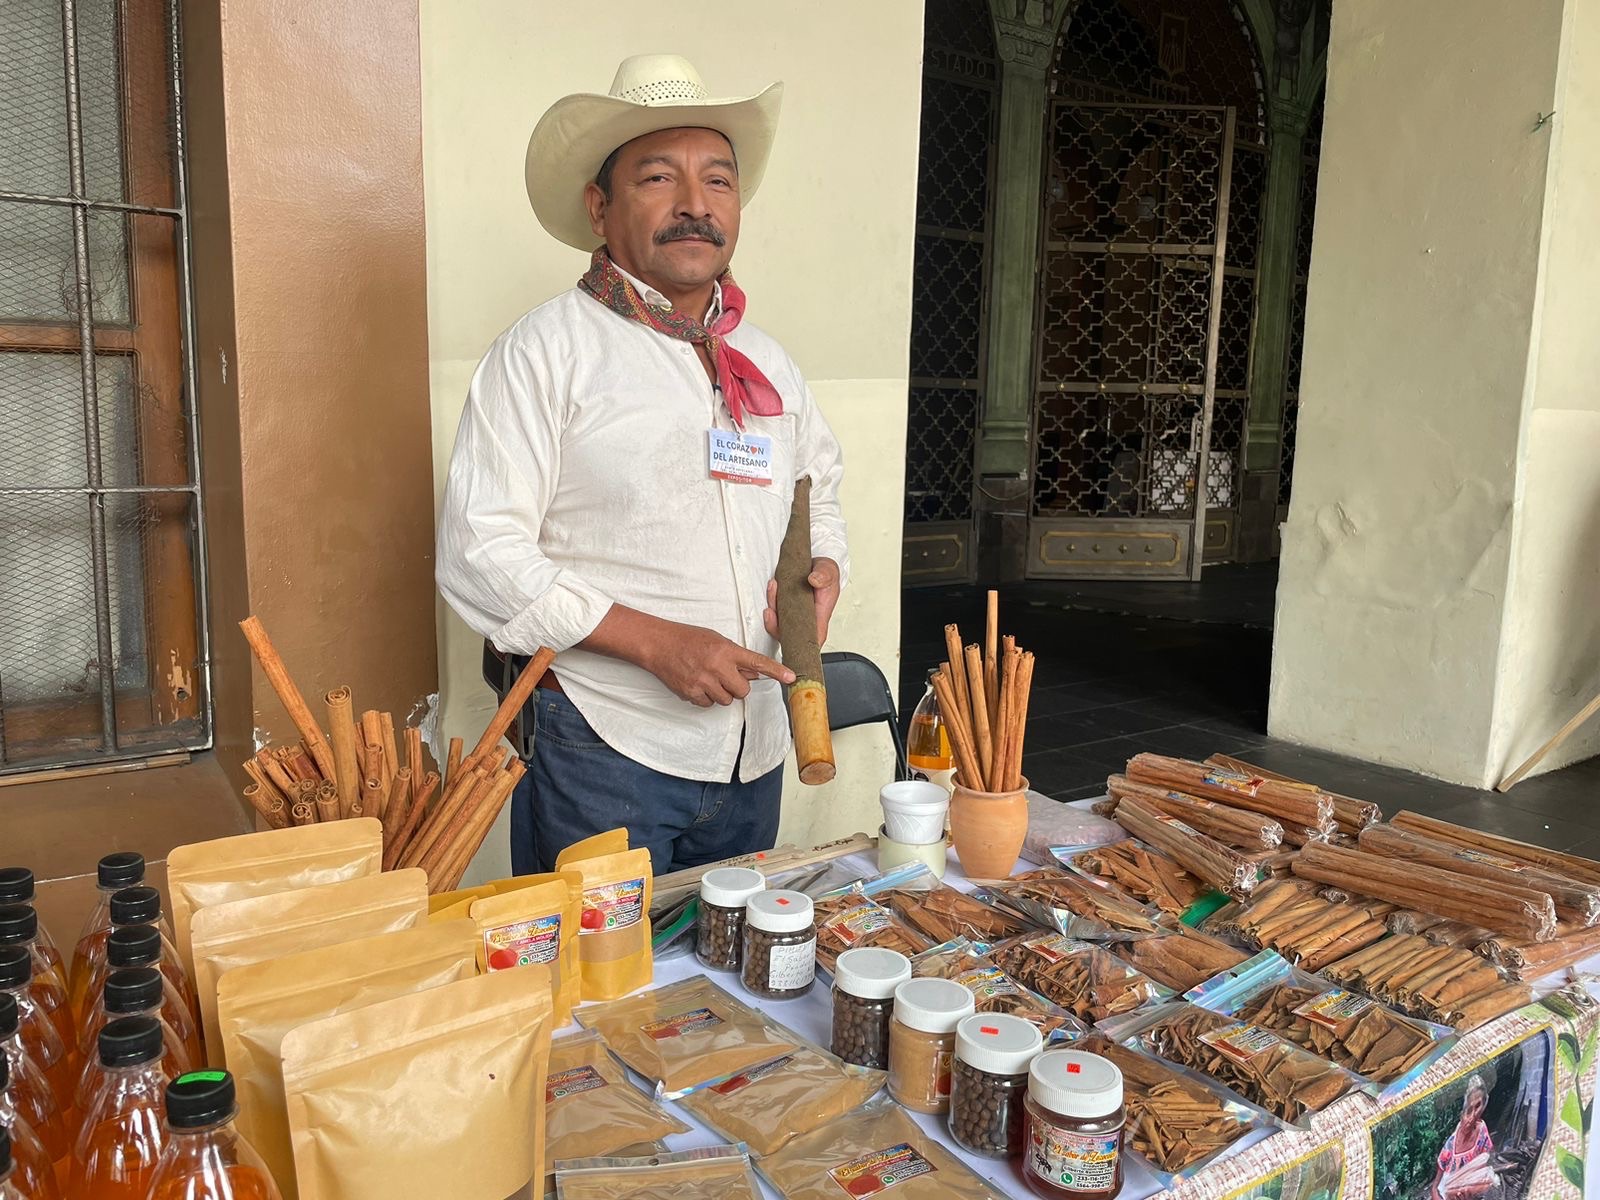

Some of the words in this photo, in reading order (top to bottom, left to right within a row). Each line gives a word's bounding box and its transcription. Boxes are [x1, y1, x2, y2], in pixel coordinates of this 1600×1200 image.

[931, 51, 987, 79] STADO
[716, 439, 725, 448] EL
[713, 452, 728, 461] DEL
[729, 455, 768, 468] ARTESANO
